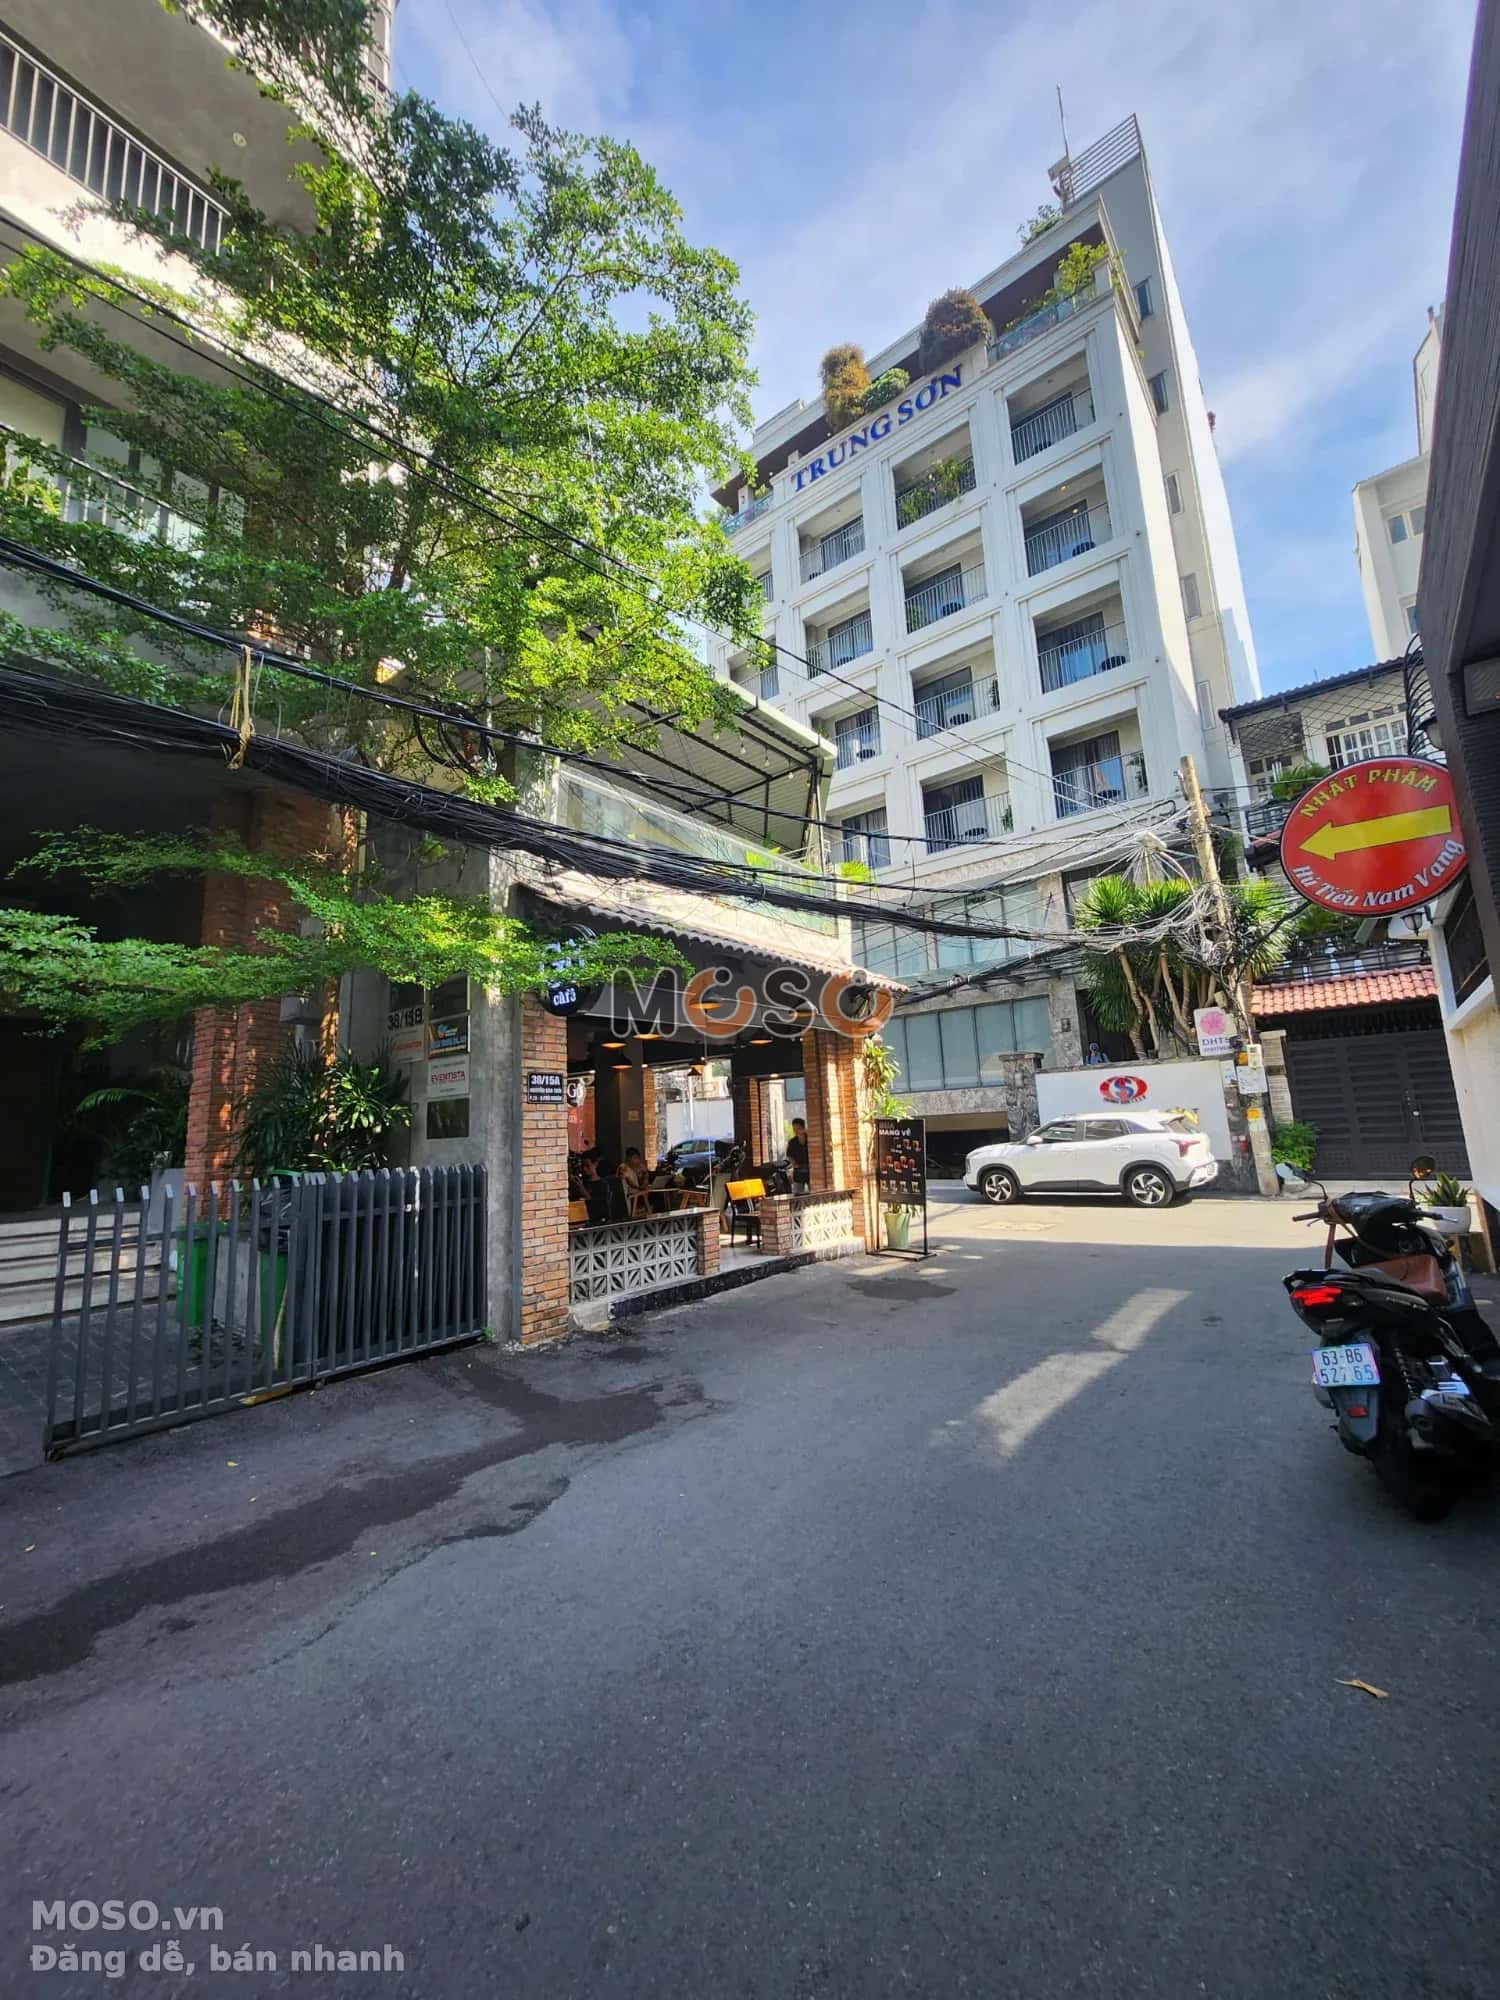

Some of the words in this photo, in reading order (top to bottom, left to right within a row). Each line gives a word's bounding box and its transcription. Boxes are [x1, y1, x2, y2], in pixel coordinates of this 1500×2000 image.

[791, 413, 891, 493] TRUNG
[897, 363, 962, 425] SƠN
[1362, 884, 1415, 907] Nam
[1413, 839, 1464, 888] Vang
[878, 1128, 900, 1136] MANG
